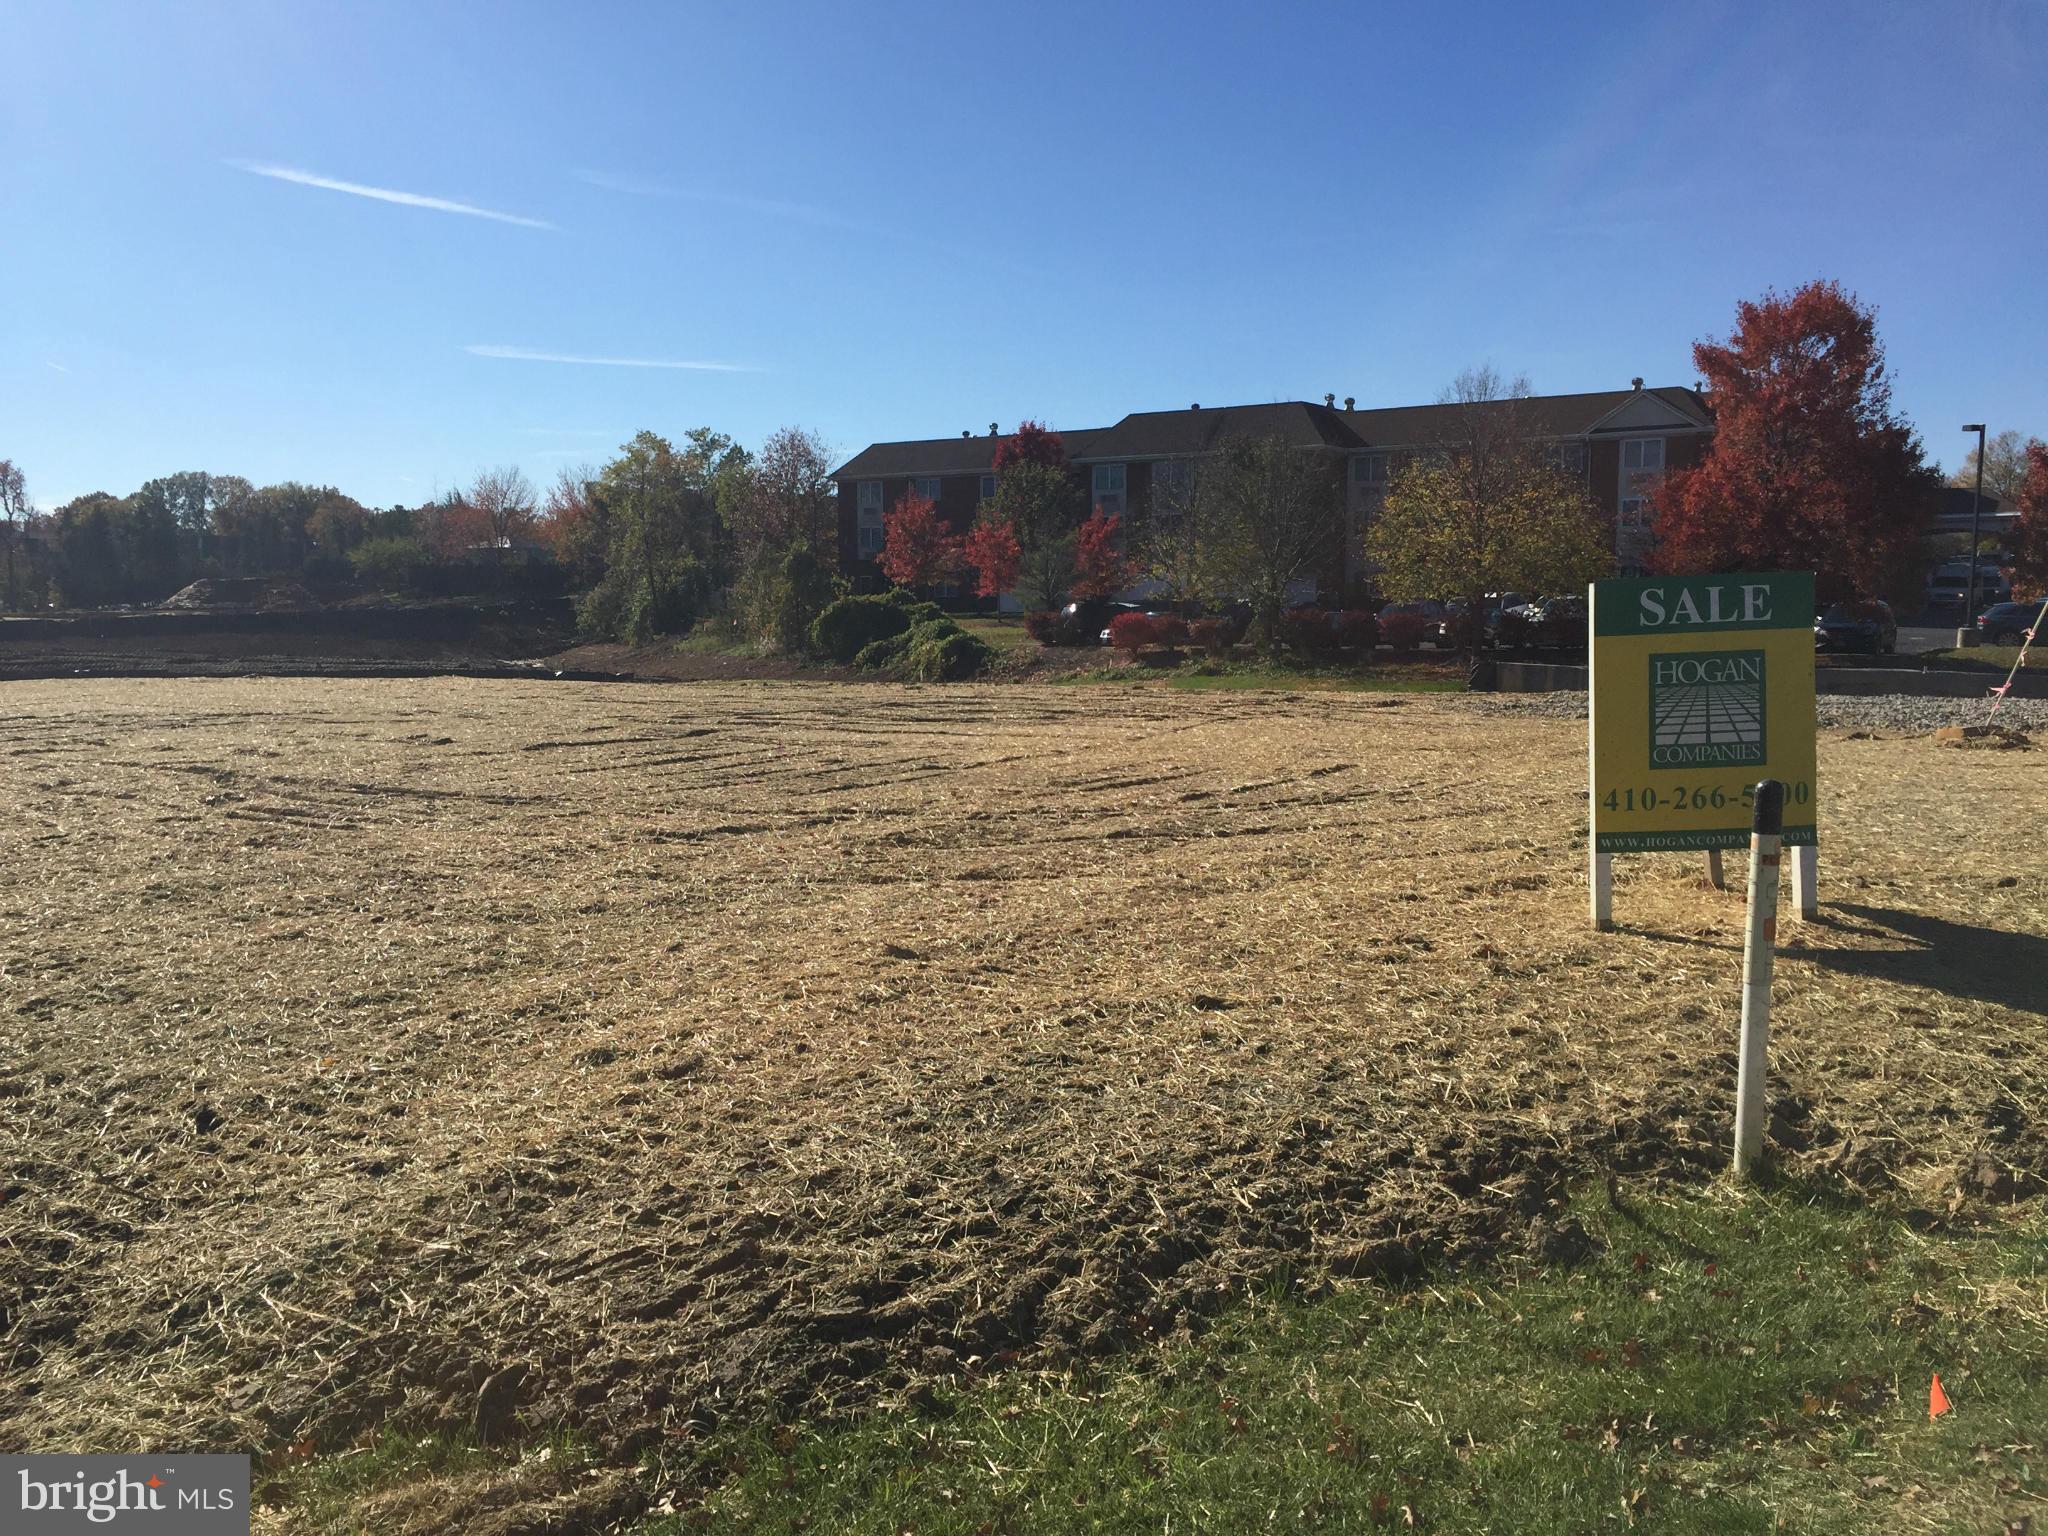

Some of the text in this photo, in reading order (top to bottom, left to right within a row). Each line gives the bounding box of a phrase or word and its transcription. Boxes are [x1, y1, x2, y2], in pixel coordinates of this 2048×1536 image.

[1640, 584, 1773, 626] SALE
[1655, 657, 1761, 685] HOGAN
[1653, 743, 1761, 763] COMPANIES
[1603, 782, 1809, 811] 410-266-500
[1601, 831, 1812, 848] WWW.HOGANCOMPACOM
